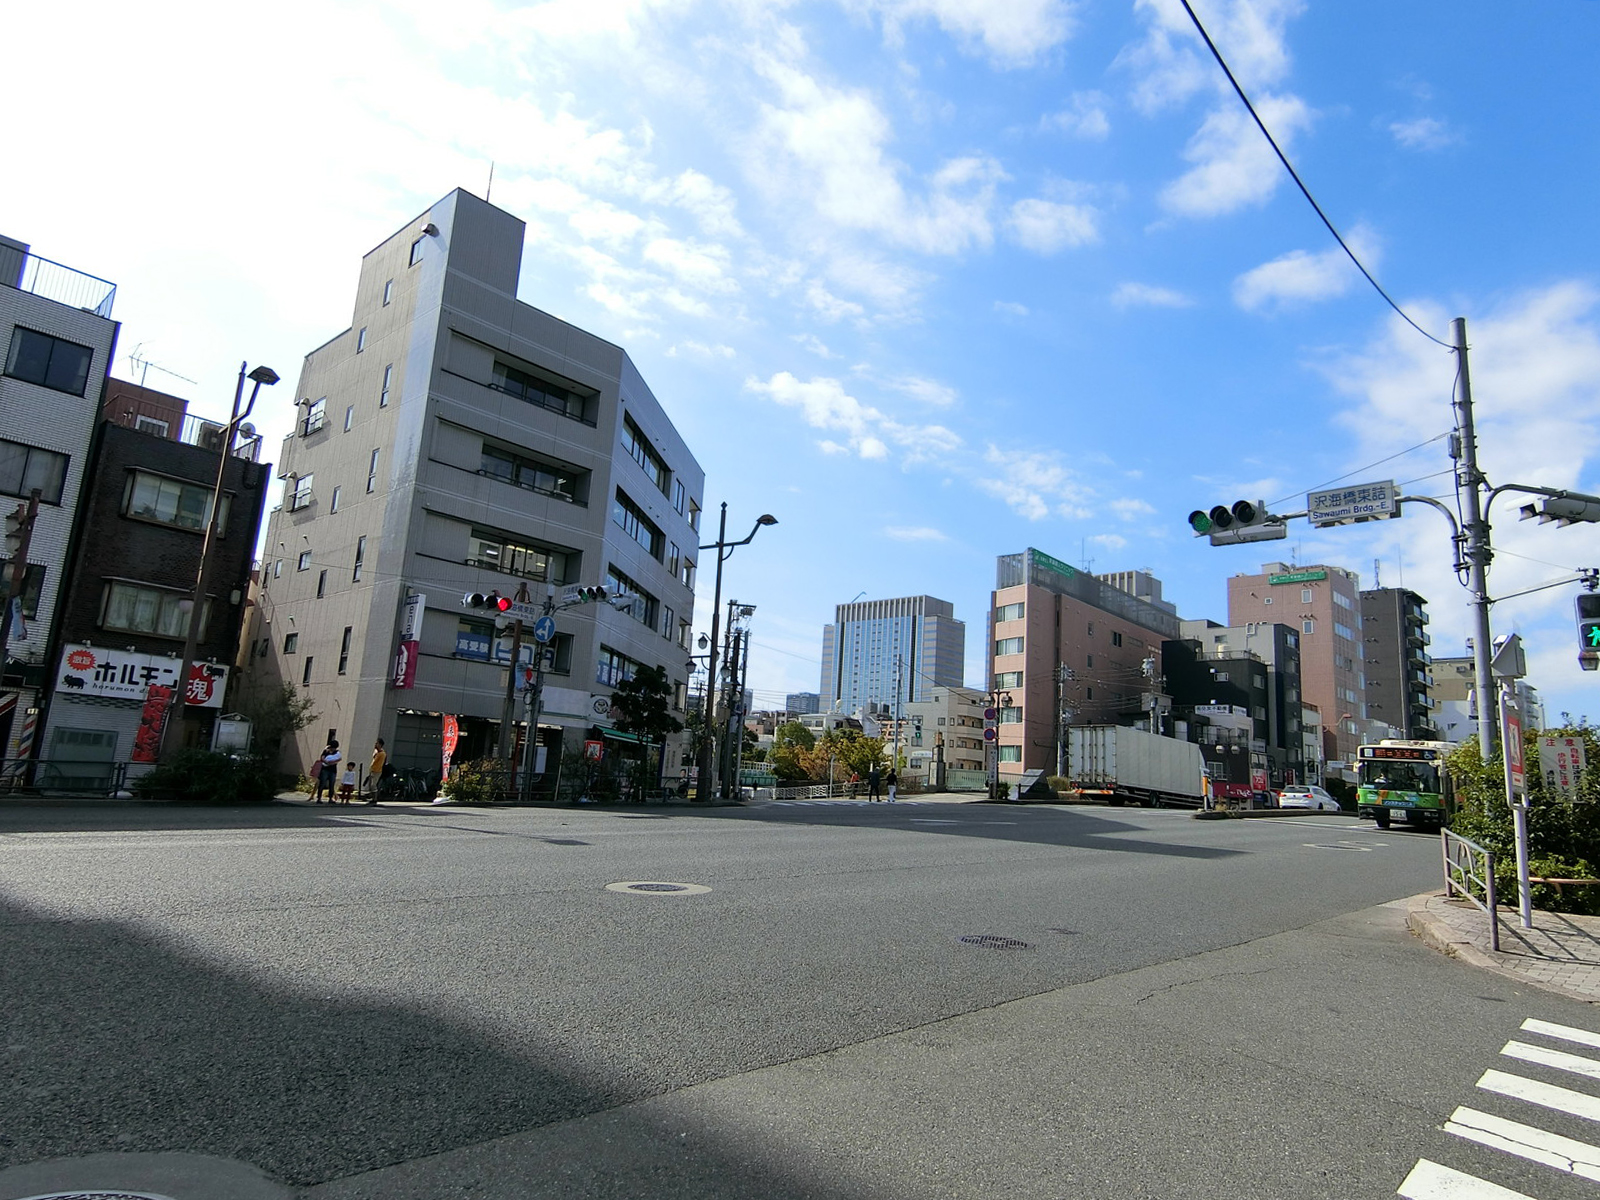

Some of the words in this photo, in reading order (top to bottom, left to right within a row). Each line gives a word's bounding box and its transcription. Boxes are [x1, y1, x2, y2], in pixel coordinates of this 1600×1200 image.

[1314, 486, 1386, 508] 沢海橋東詰
[1313, 507, 1351, 519] Sawaumi
[456, 638, 490, 655] 高受験
[94, 661, 178, 689] ホルモン
[92, 682, 136, 693] horumon
[186, 679, 209, 701] 魂
